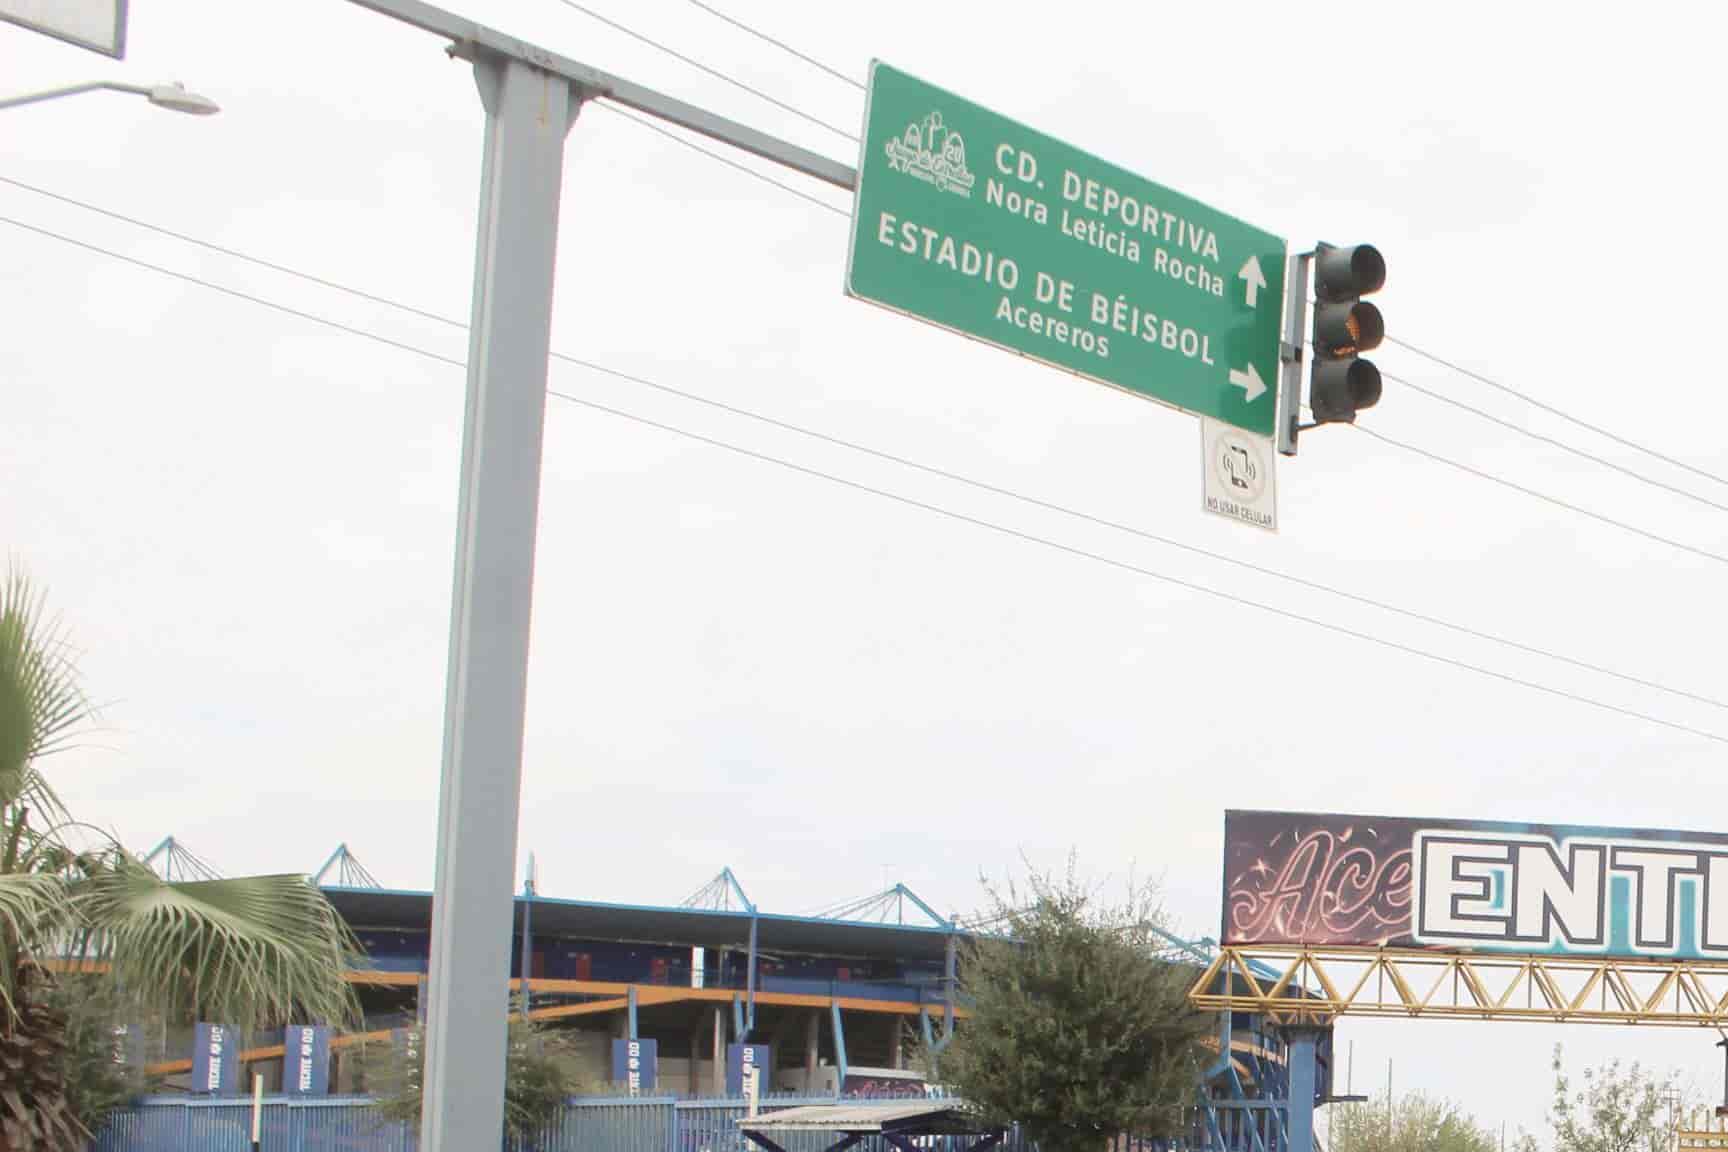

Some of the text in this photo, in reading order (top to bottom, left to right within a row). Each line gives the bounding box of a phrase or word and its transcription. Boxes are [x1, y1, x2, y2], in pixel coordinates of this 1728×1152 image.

[986, 178, 1048, 225] Nora
[1061, 209, 1140, 263] Leticia
[1154, 248, 1225, 297] Rocha
[995, 144, 1045, 190] CD.
[1063, 169, 1219, 262] DEPORTIVA
[878, 212, 1216, 366] ESTADIO DE BÉISBOL
[996, 297, 1110, 358] Acereros
[1220, 500, 1240, 515] USAR
[1241, 506, 1273, 526] CELULAR
